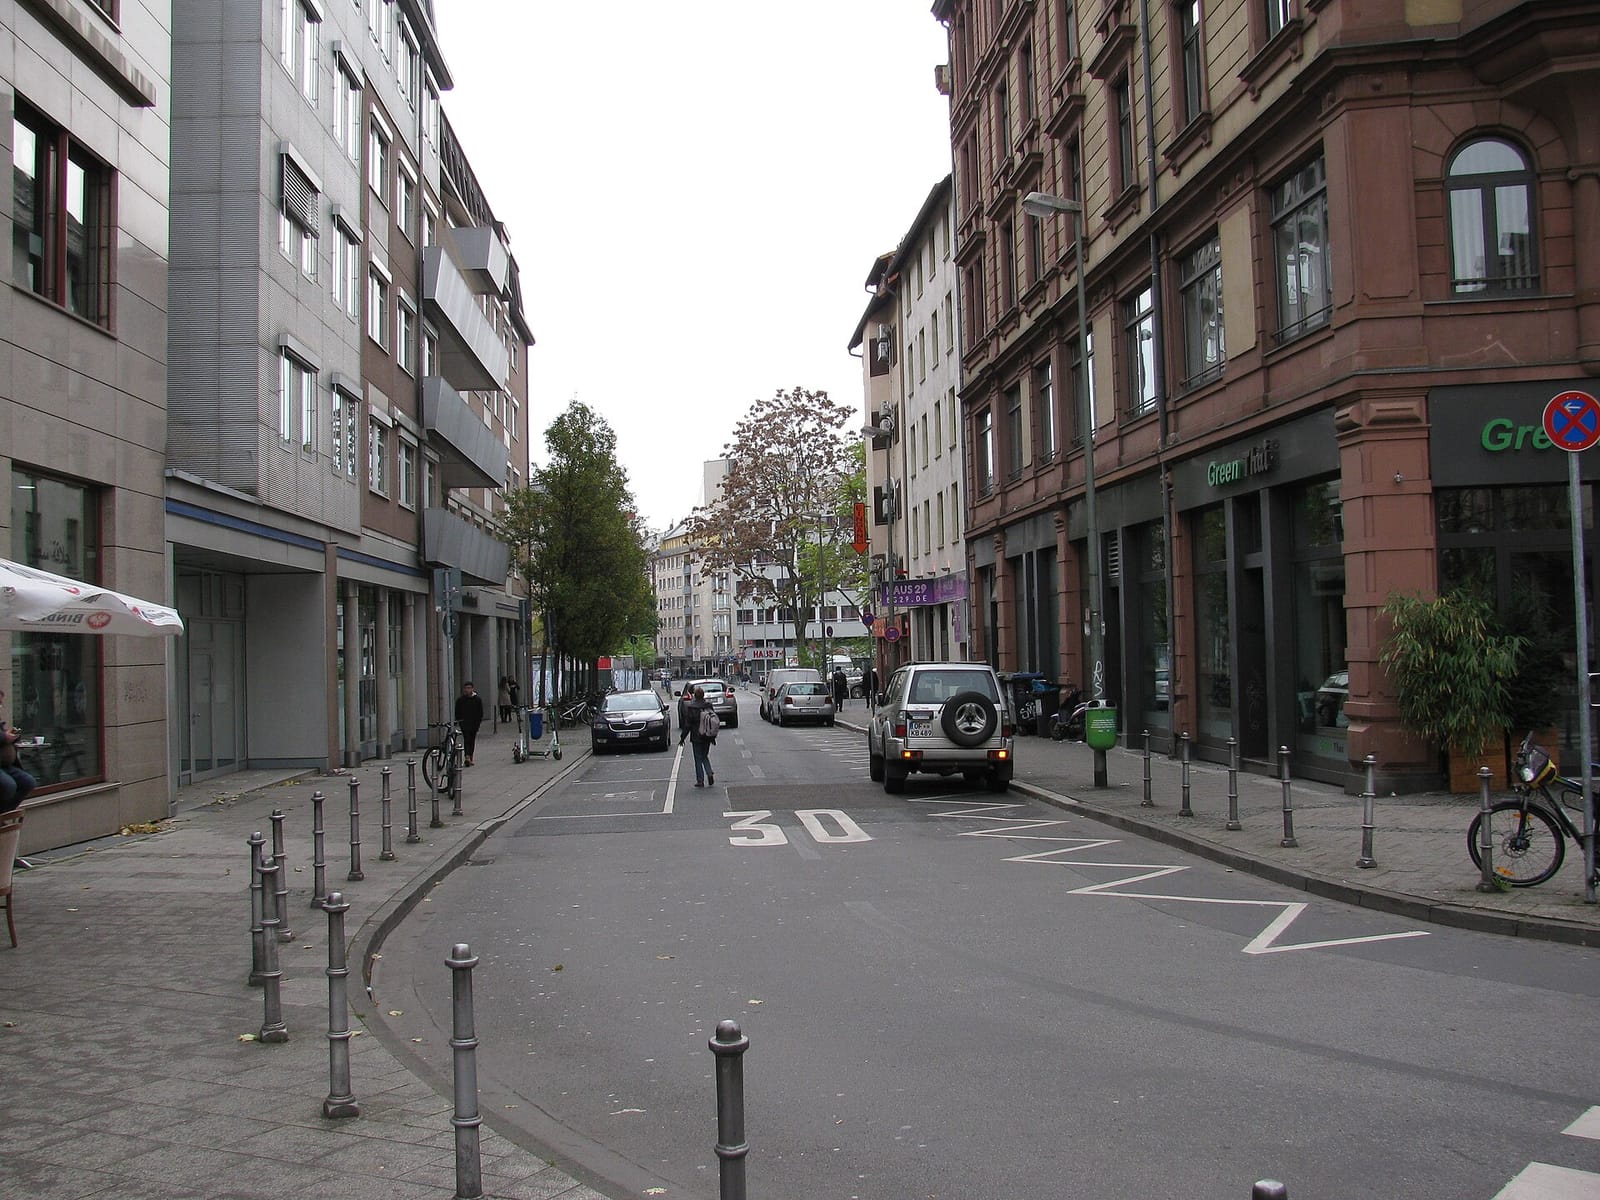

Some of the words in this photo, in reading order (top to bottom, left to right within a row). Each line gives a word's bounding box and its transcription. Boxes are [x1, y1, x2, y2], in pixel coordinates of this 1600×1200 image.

[1482, 418, 1554, 451] Gre
[1207, 460, 1240, 487] Green
[914, 584, 928, 594] 29
[723, 809, 873, 847] 30
